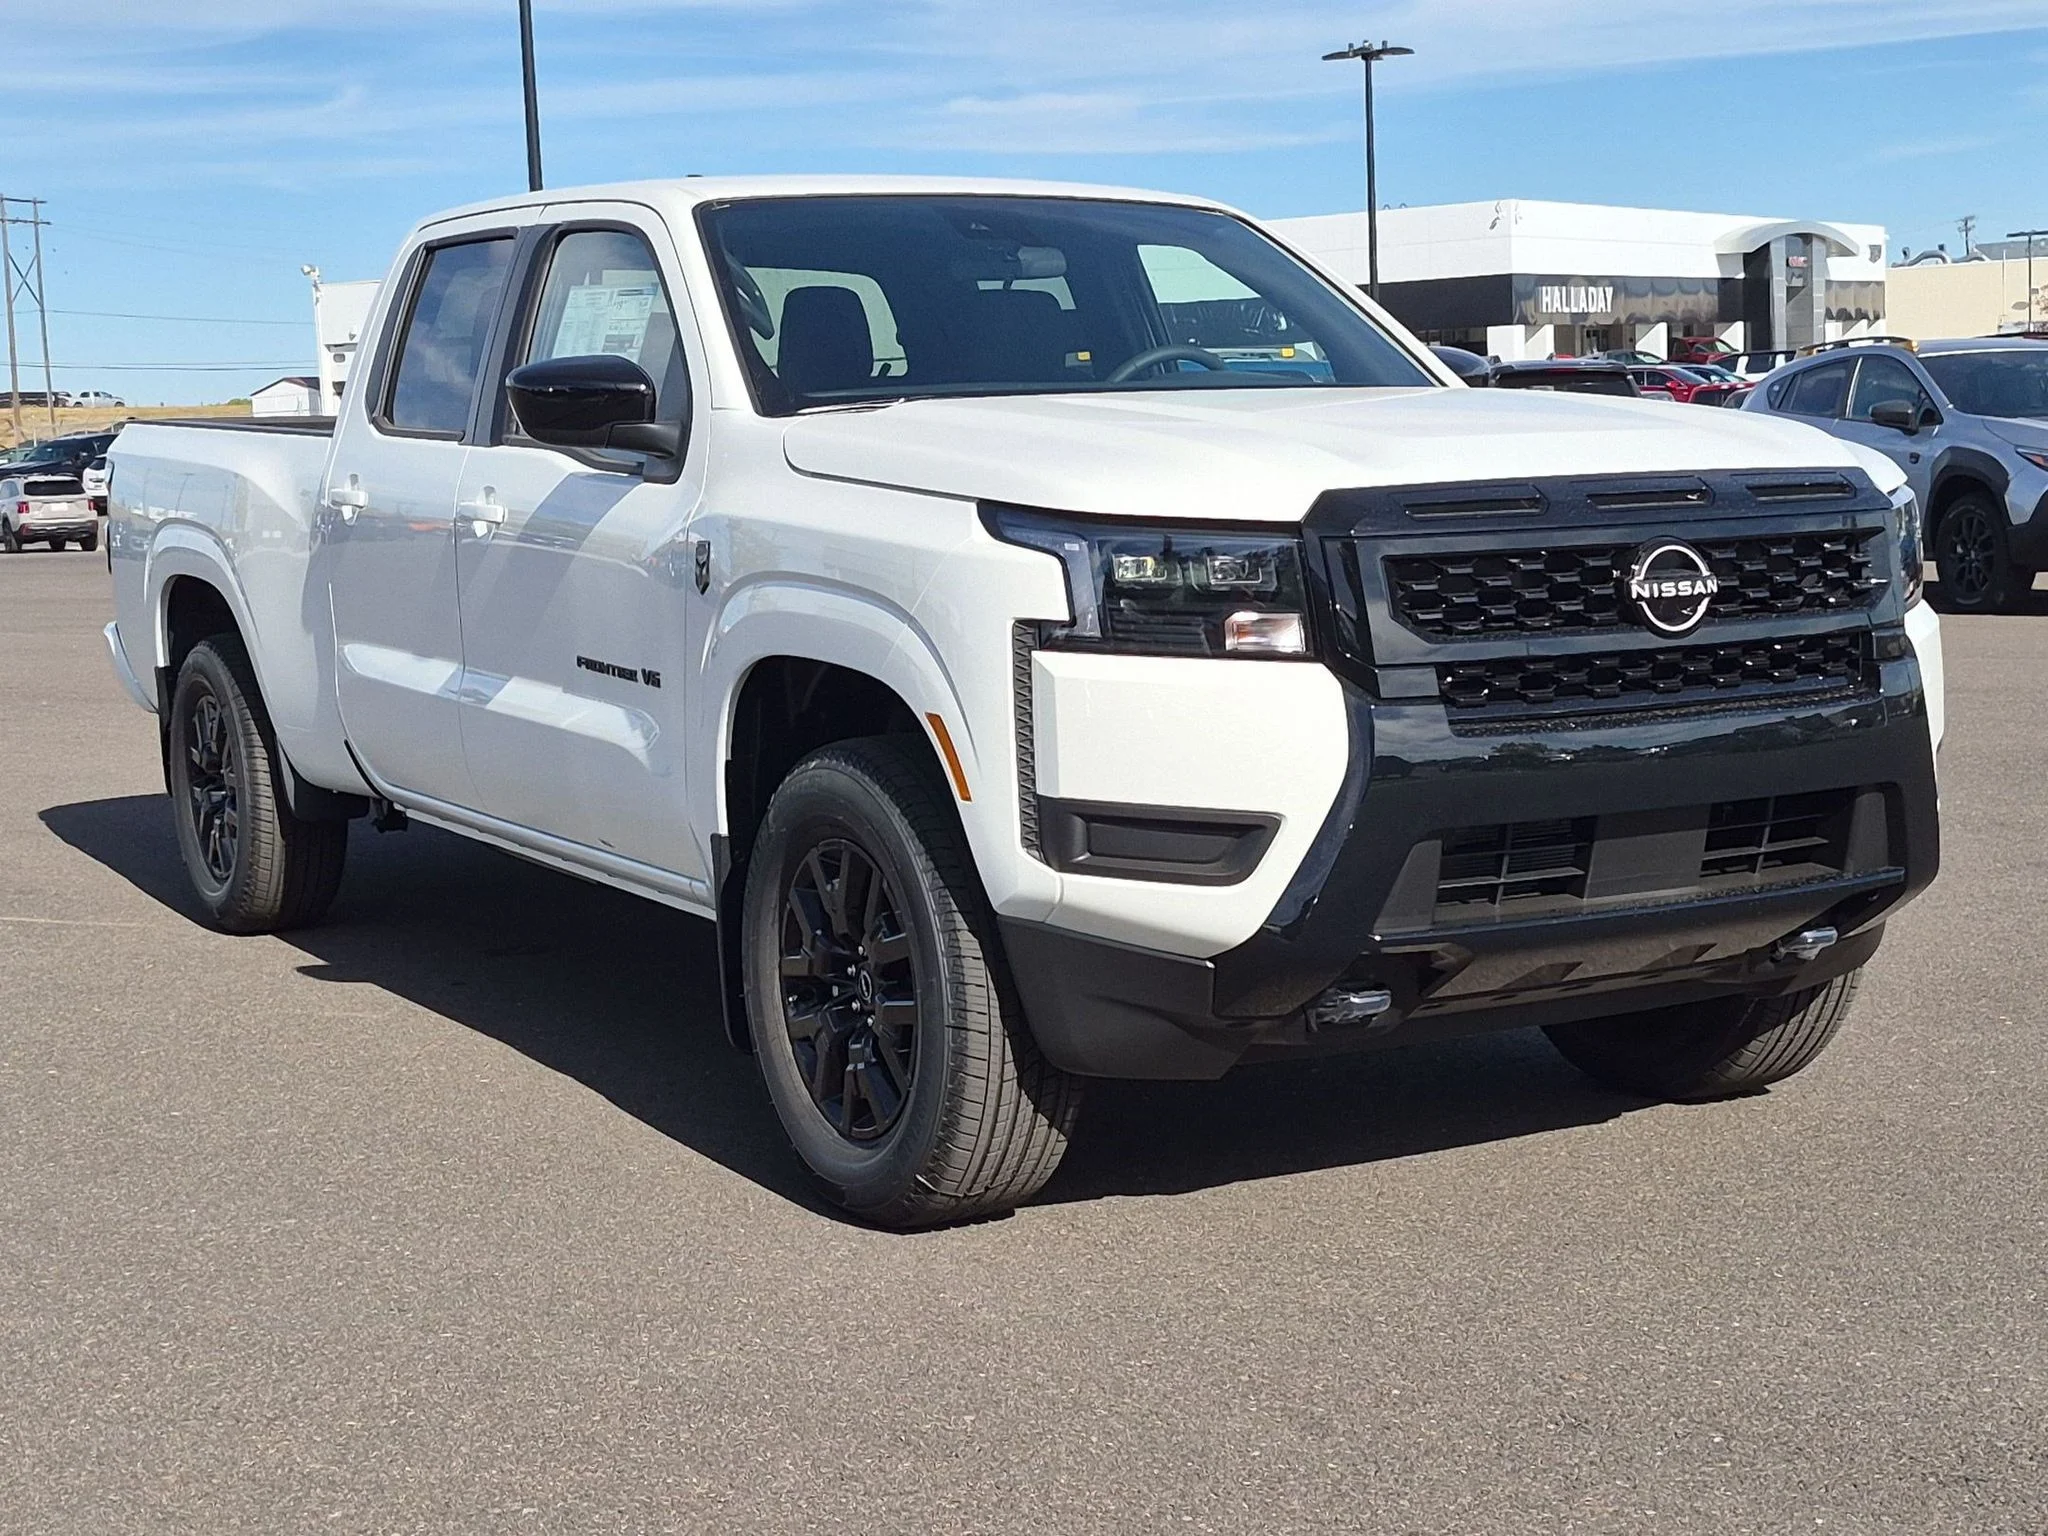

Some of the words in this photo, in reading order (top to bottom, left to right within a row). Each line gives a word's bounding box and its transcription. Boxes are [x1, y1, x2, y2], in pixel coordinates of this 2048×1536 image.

[1541, 286, 1614, 313] HALLADAY
[1630, 578, 1719, 599] NISSAN
[576, 655, 639, 683] FRONTIER
